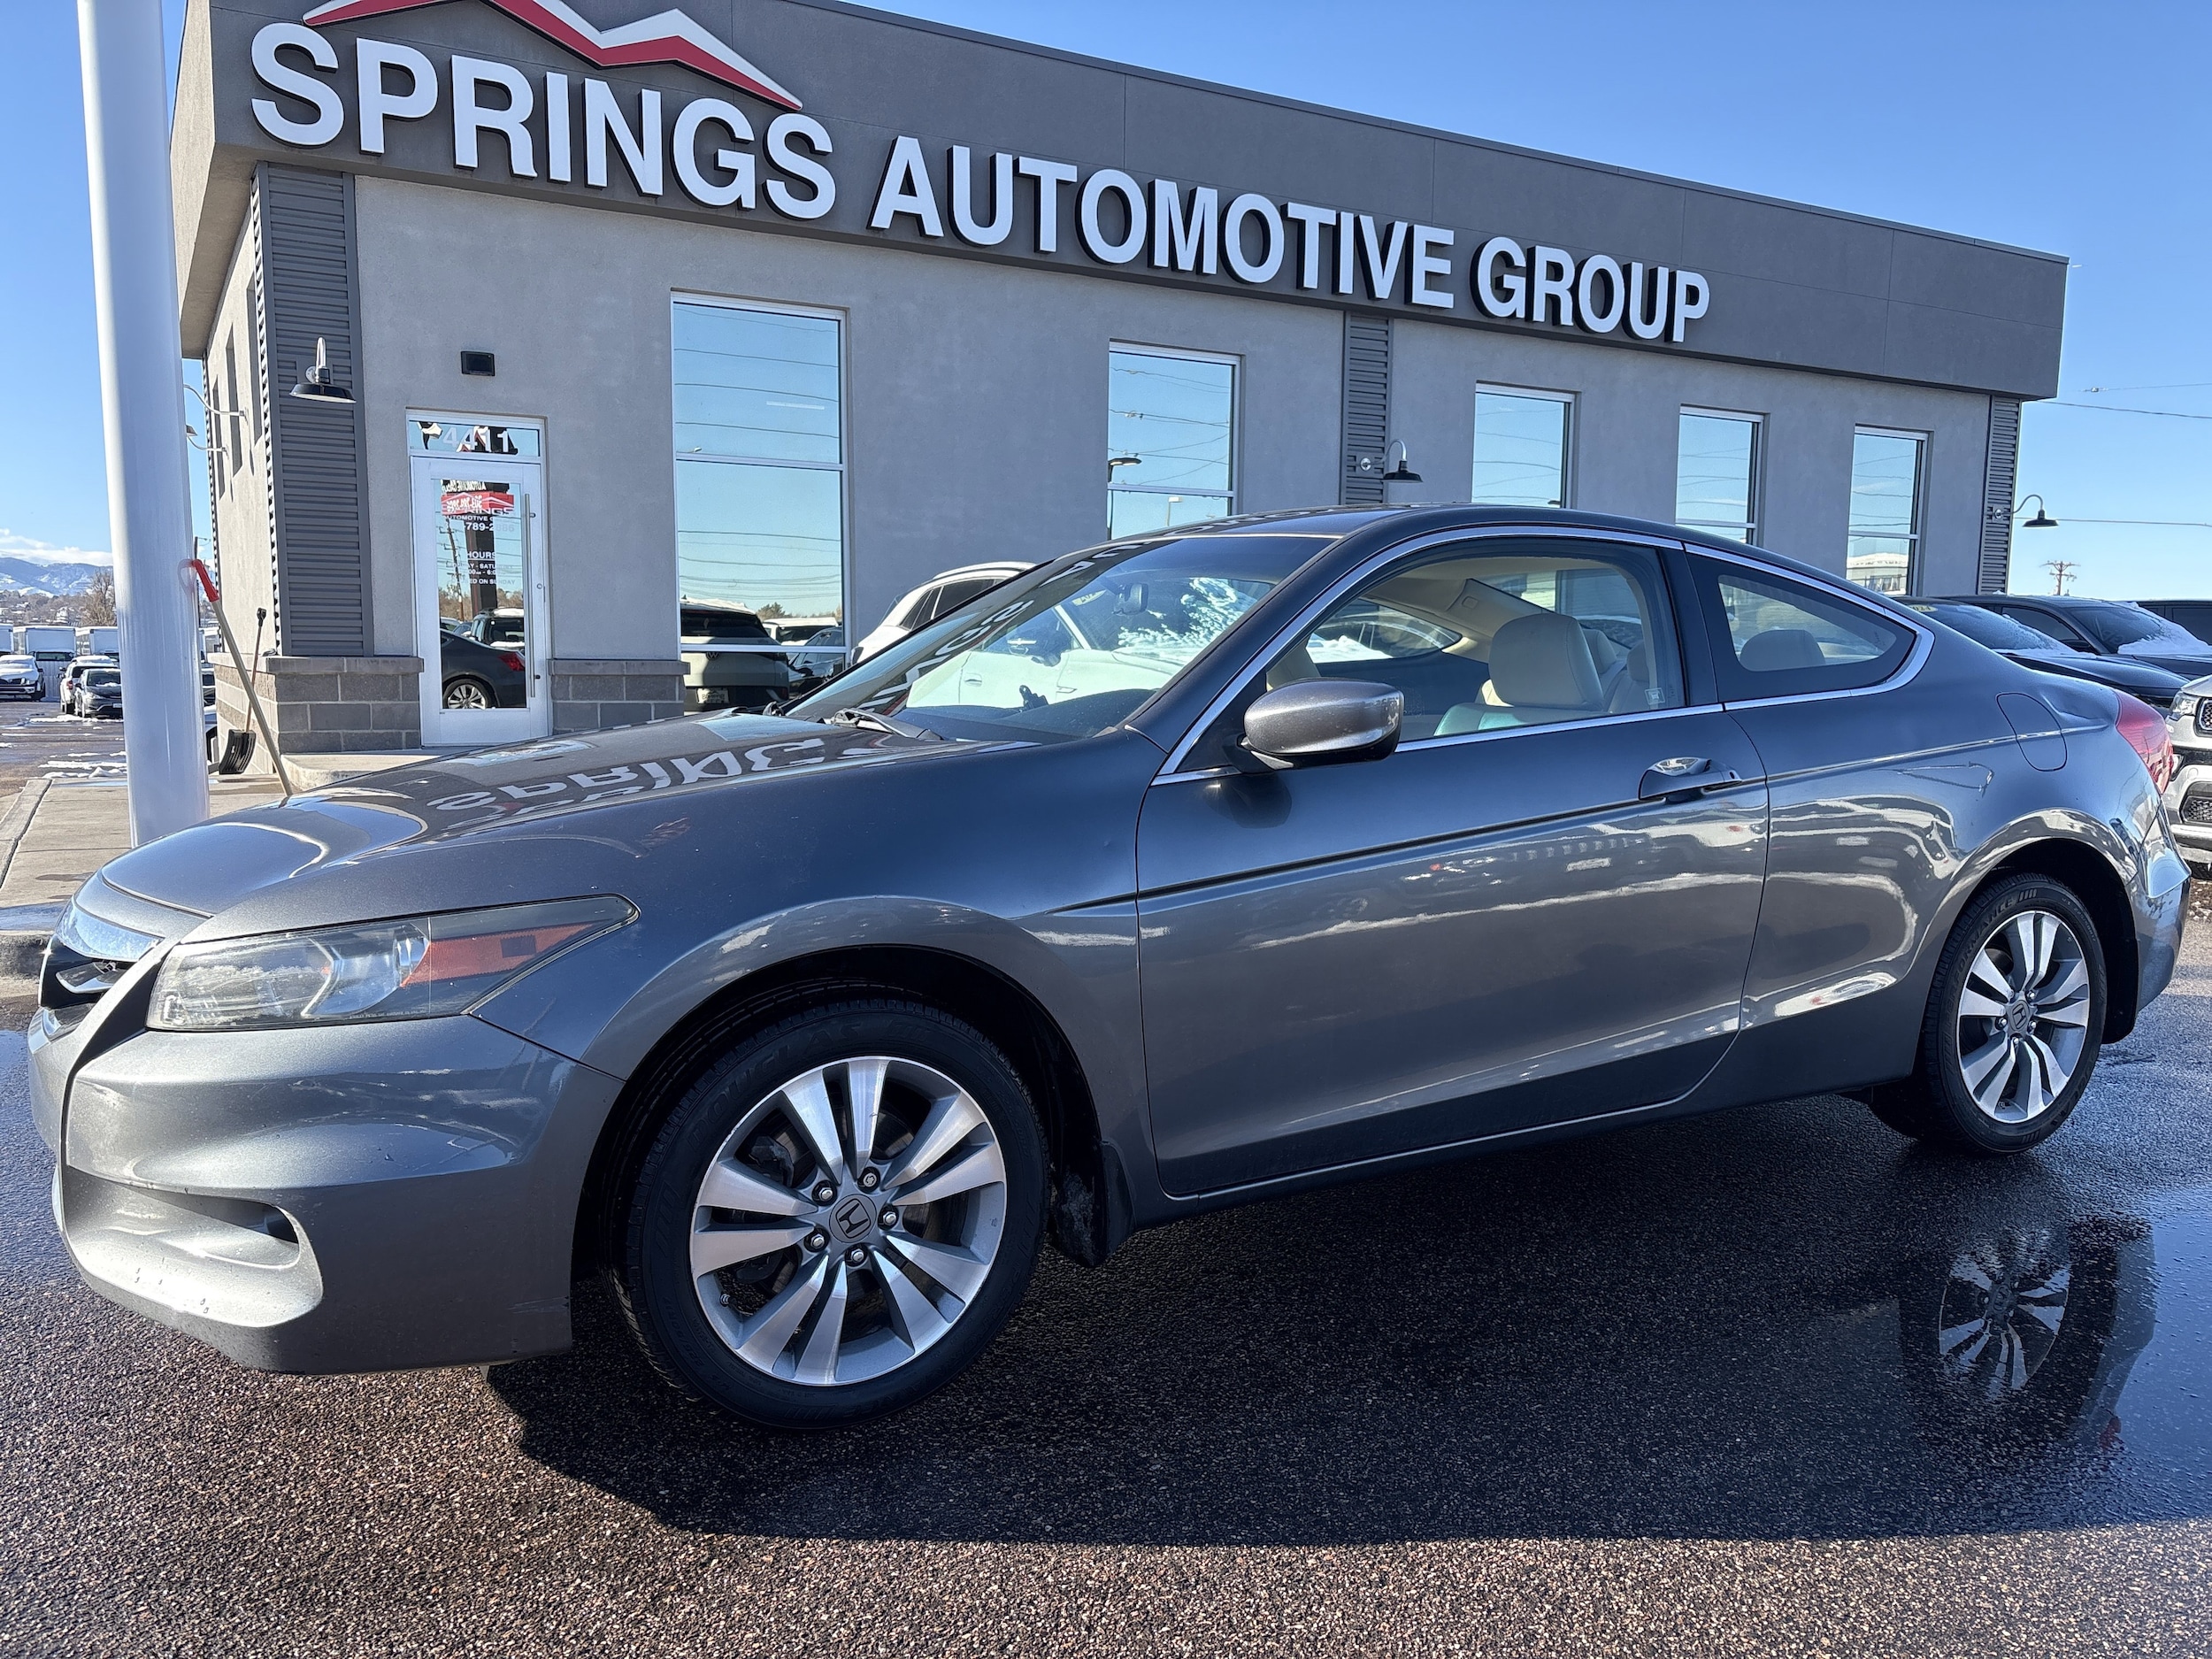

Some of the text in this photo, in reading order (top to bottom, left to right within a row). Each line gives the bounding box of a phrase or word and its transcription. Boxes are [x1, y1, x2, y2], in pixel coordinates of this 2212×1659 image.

[250, 22, 1710, 343] SPRINGS AUTOMOTIVE GROUP
[442, 426, 510, 452] 4411
[467, 550, 495, 559] HOURS
